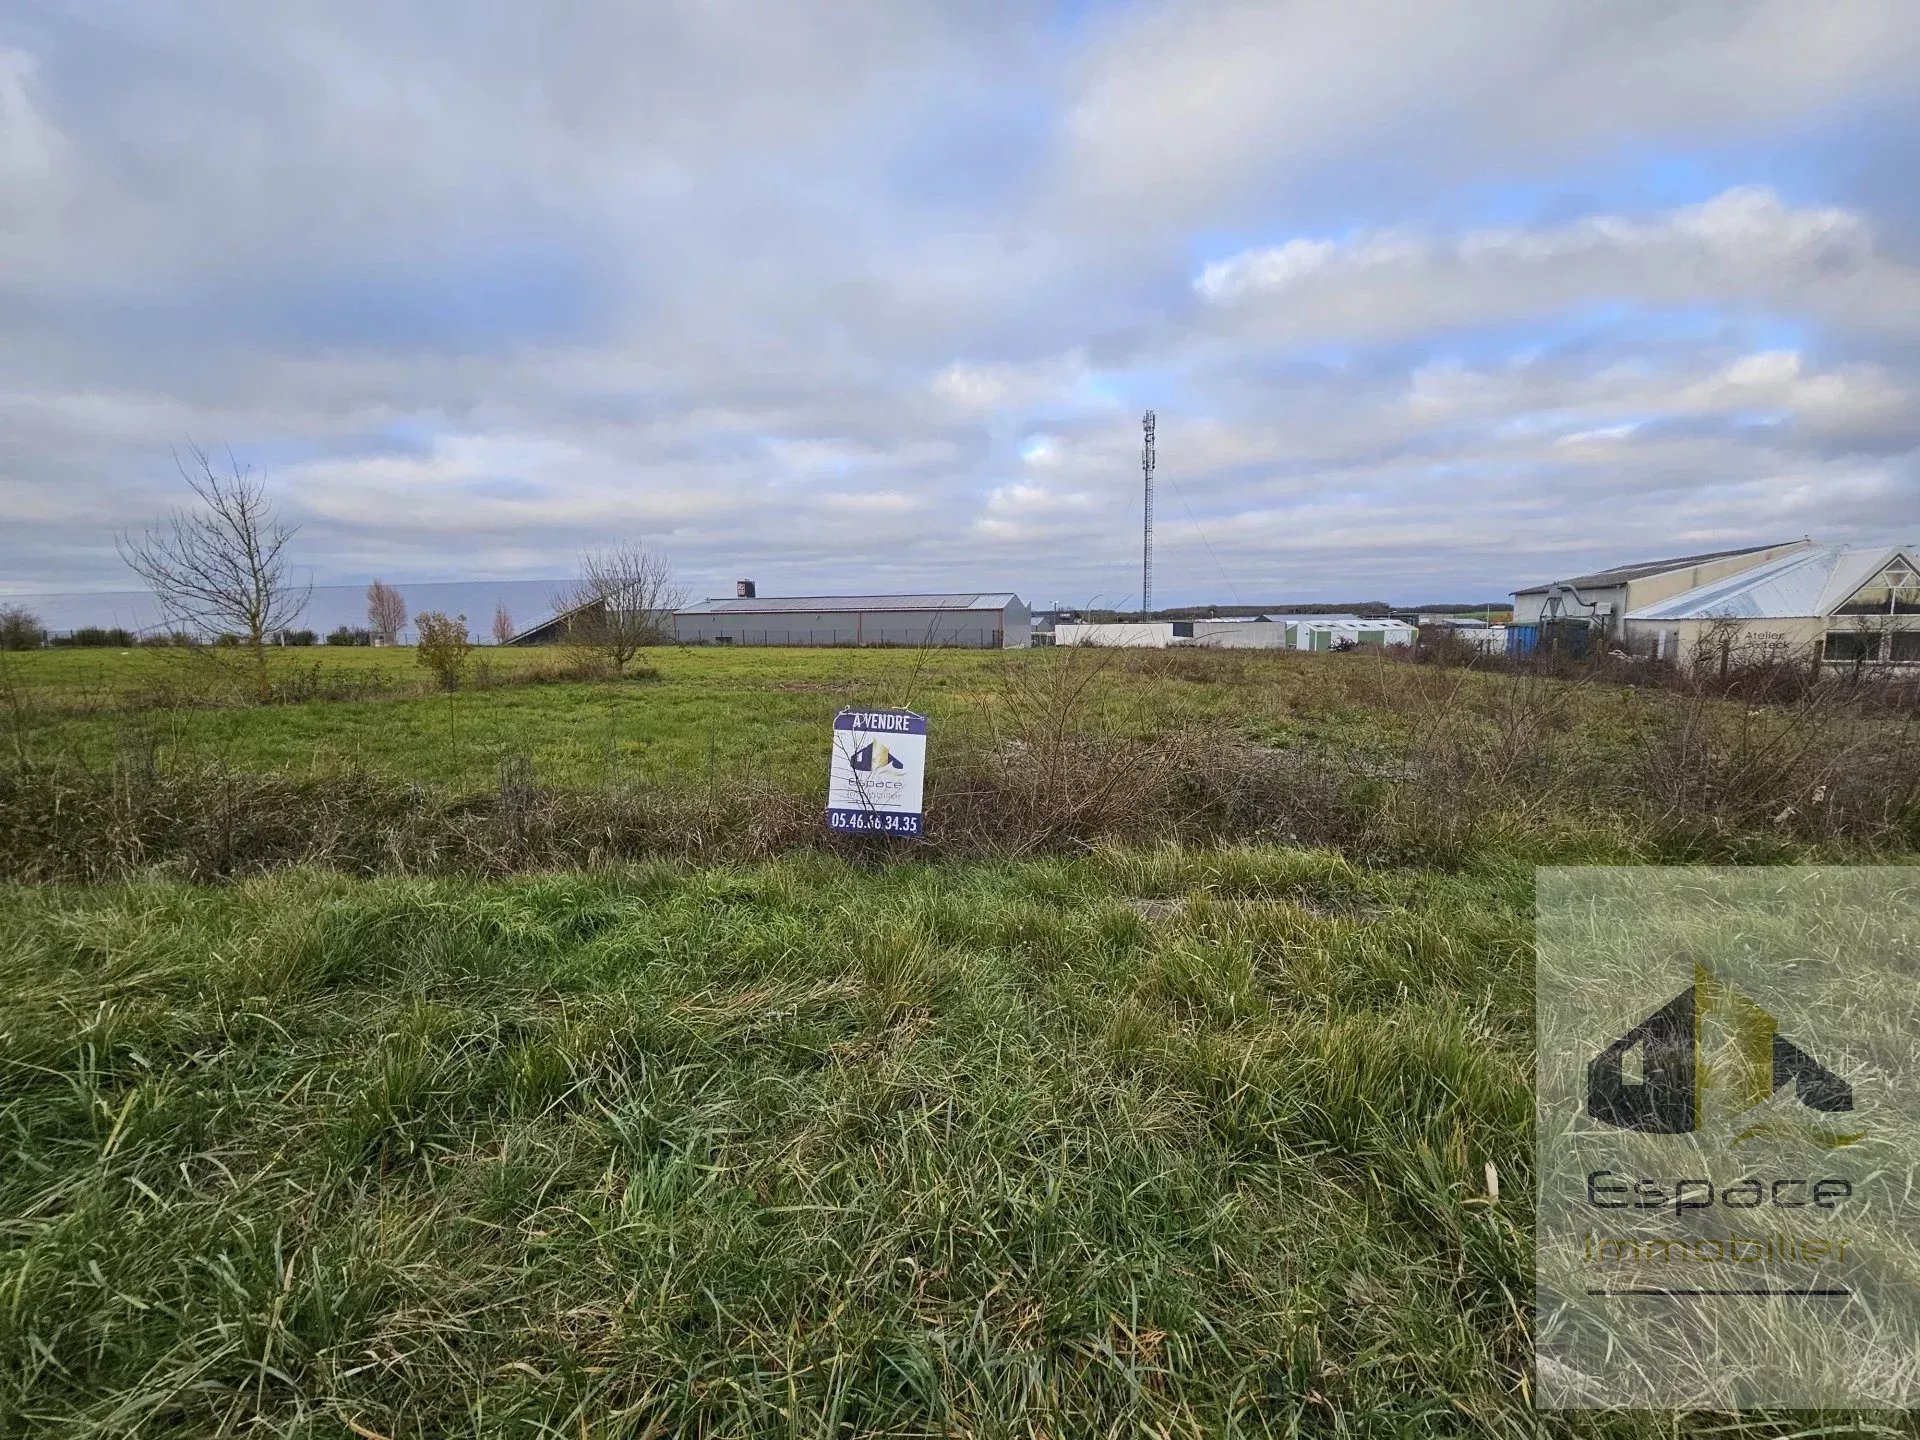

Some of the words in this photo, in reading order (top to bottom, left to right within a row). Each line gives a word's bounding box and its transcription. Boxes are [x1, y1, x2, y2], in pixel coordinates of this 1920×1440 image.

[1744, 631, 1784, 640] Atelier
[853, 713, 861, 728] A
[864, 713, 909, 730] VENDRE
